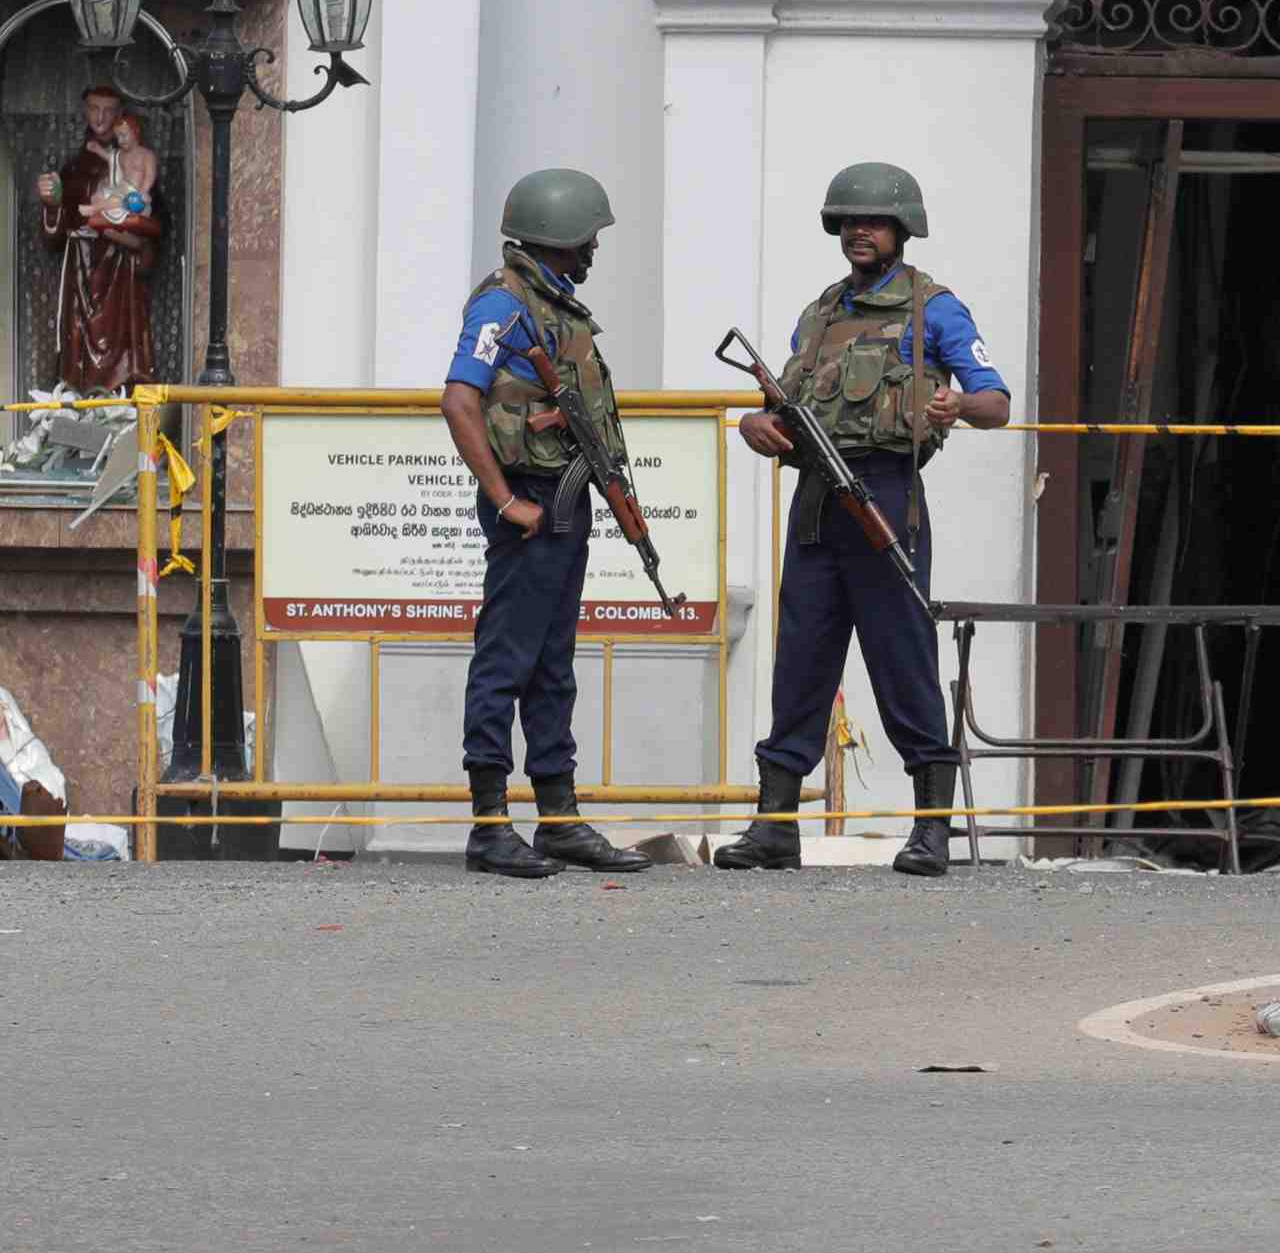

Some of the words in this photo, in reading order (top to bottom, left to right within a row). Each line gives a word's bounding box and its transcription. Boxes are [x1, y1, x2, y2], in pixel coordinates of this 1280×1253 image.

[327, 454, 384, 466] VEHICLE
[388, 455, 448, 467] PARKING
[451, 455, 464, 467] IS
[634, 457, 663, 468] AND
[408, 474, 465, 486] VEHICLE
[286, 603, 308, 617] ST.
[311, 603, 402, 618] ANTHONY'S
[406, 604, 468, 620] SHRINE,
[678, 607, 699, 620] 13.
